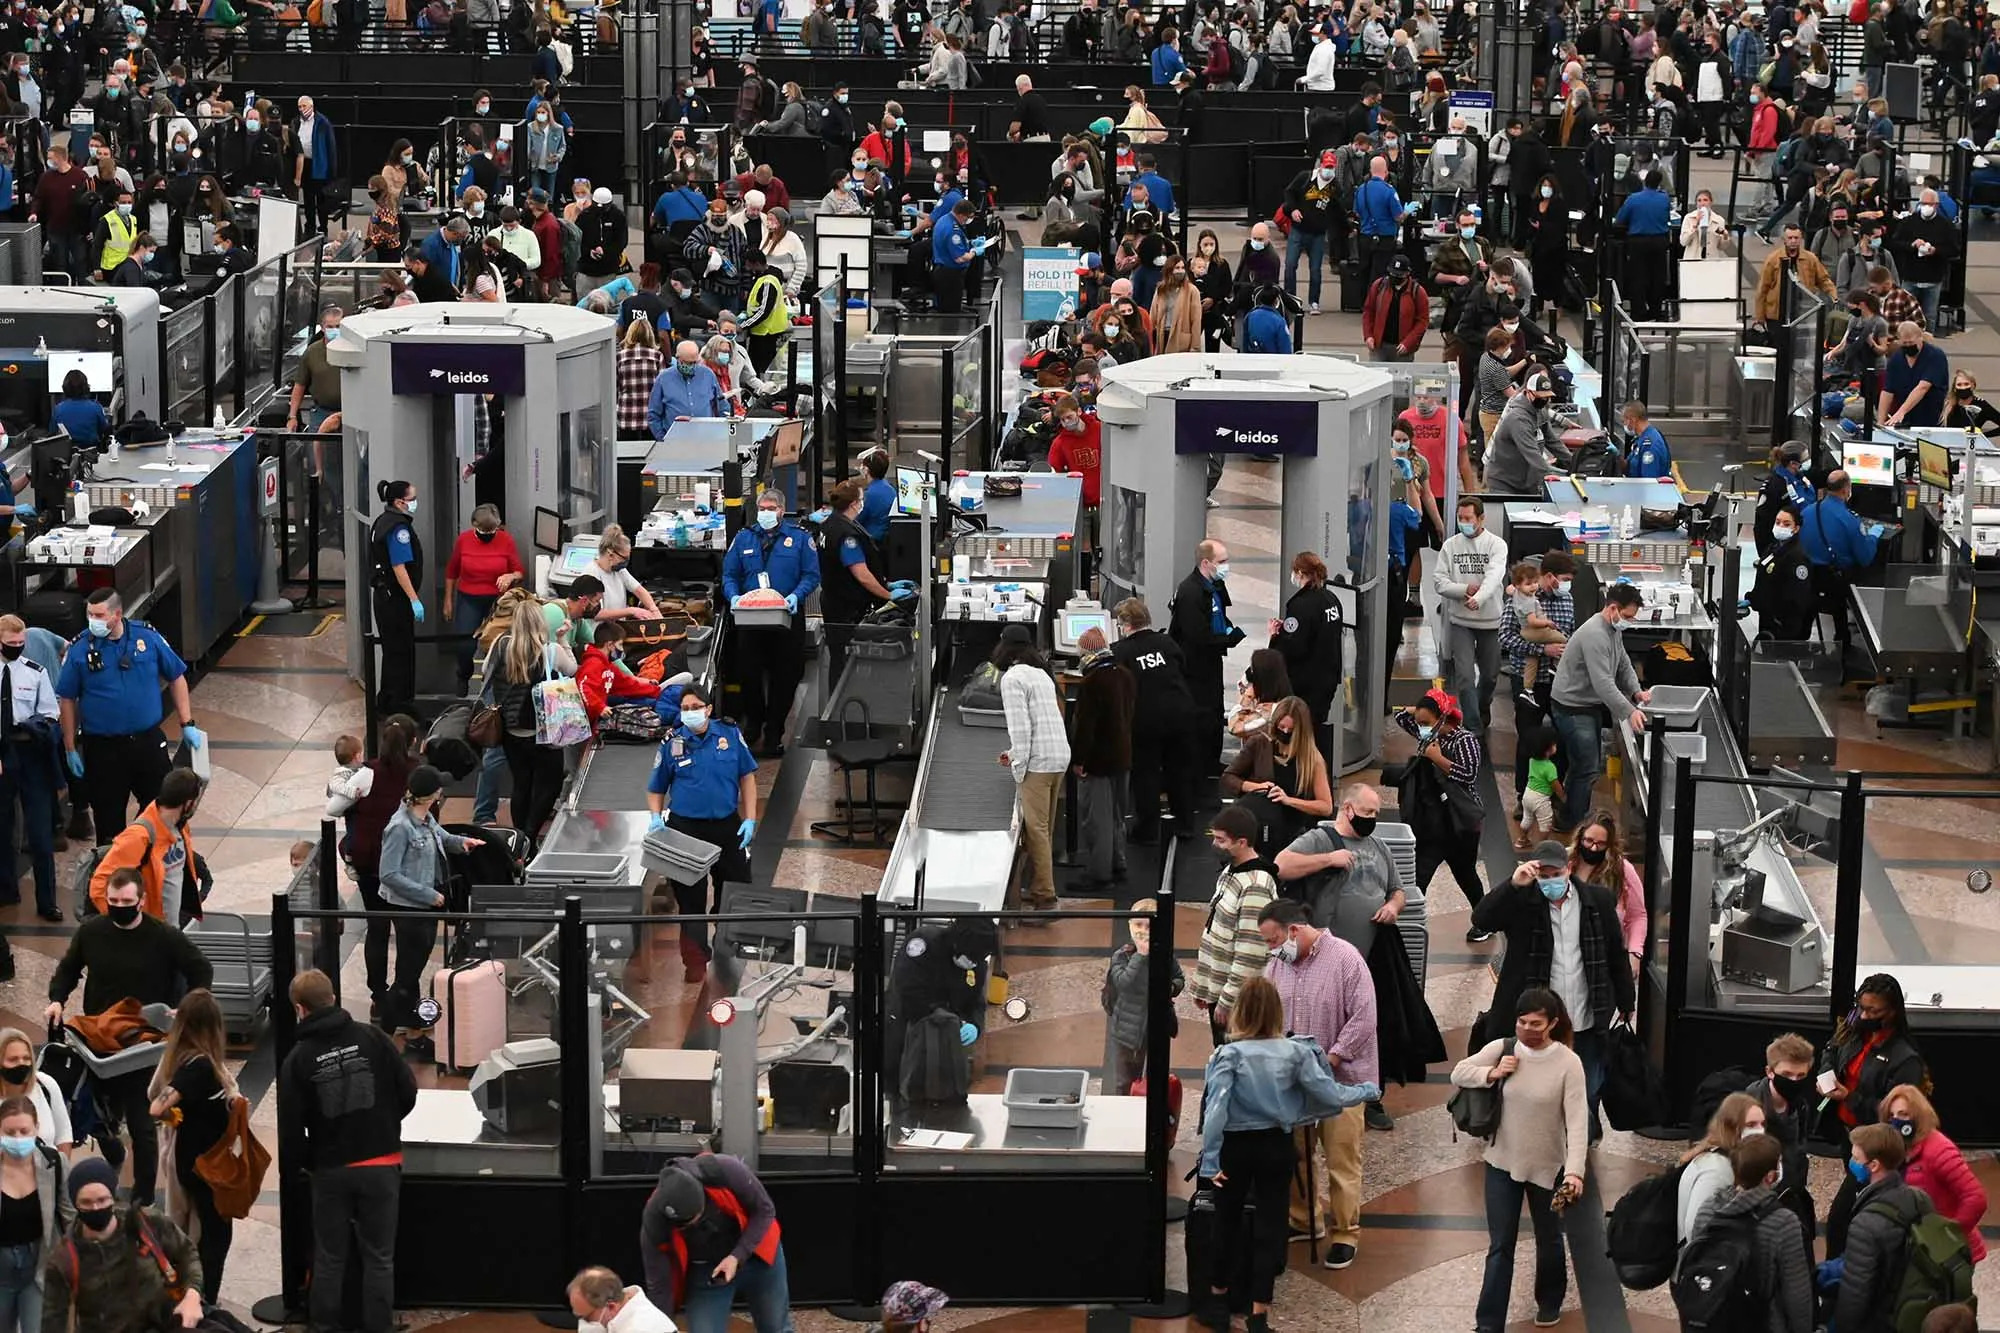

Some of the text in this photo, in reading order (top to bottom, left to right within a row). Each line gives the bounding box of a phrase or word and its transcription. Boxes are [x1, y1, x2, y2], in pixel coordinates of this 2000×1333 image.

[1028, 271, 1073, 280] HOLD IT
[1028, 281, 1073, 289] REFILL IT
[631, 309, 648, 320] TSA
[447, 371, 489, 383] leidos
[730, 423, 735, 435] 5
[1234, 430, 1279, 444] leidos
[1969, 439, 1975, 450] 8
[922, 488, 928, 500] 6
[1732, 501, 1738, 513] 7
[1136, 652, 1166, 670] TSA
